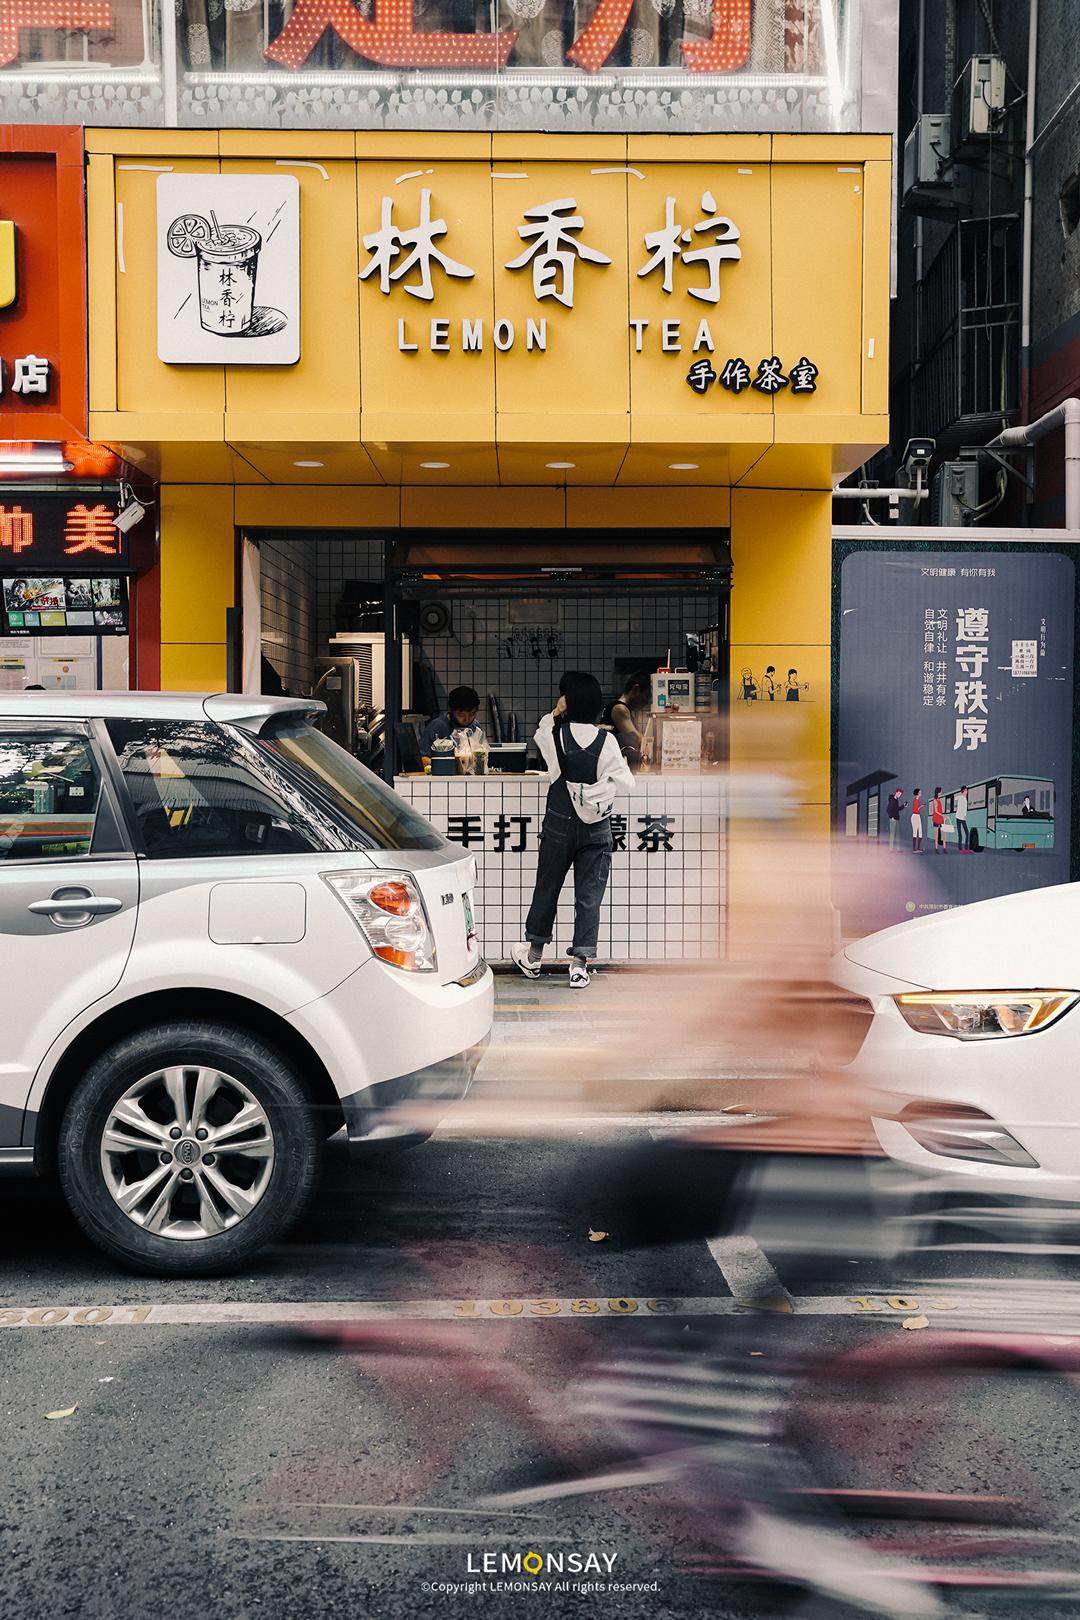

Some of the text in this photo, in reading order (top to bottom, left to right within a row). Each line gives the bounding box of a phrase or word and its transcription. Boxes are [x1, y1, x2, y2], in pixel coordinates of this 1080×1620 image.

[358, 188, 742, 309] 林香柠
[219, 268, 237, 328] 林香柠
[398, 319, 716, 353] LEMON TEA
[686, 357, 819, 394] 手作茶室
[921, 567, 996, 577] 文明健康 有你有我
[922, 608, 935, 706] 自觉自律 和谐稳定
[935, 608, 948, 707] 文明礼让 井井有条
[953, 607, 989, 751] 遵守秩序
[446, 814, 676, 853] 手打茶
